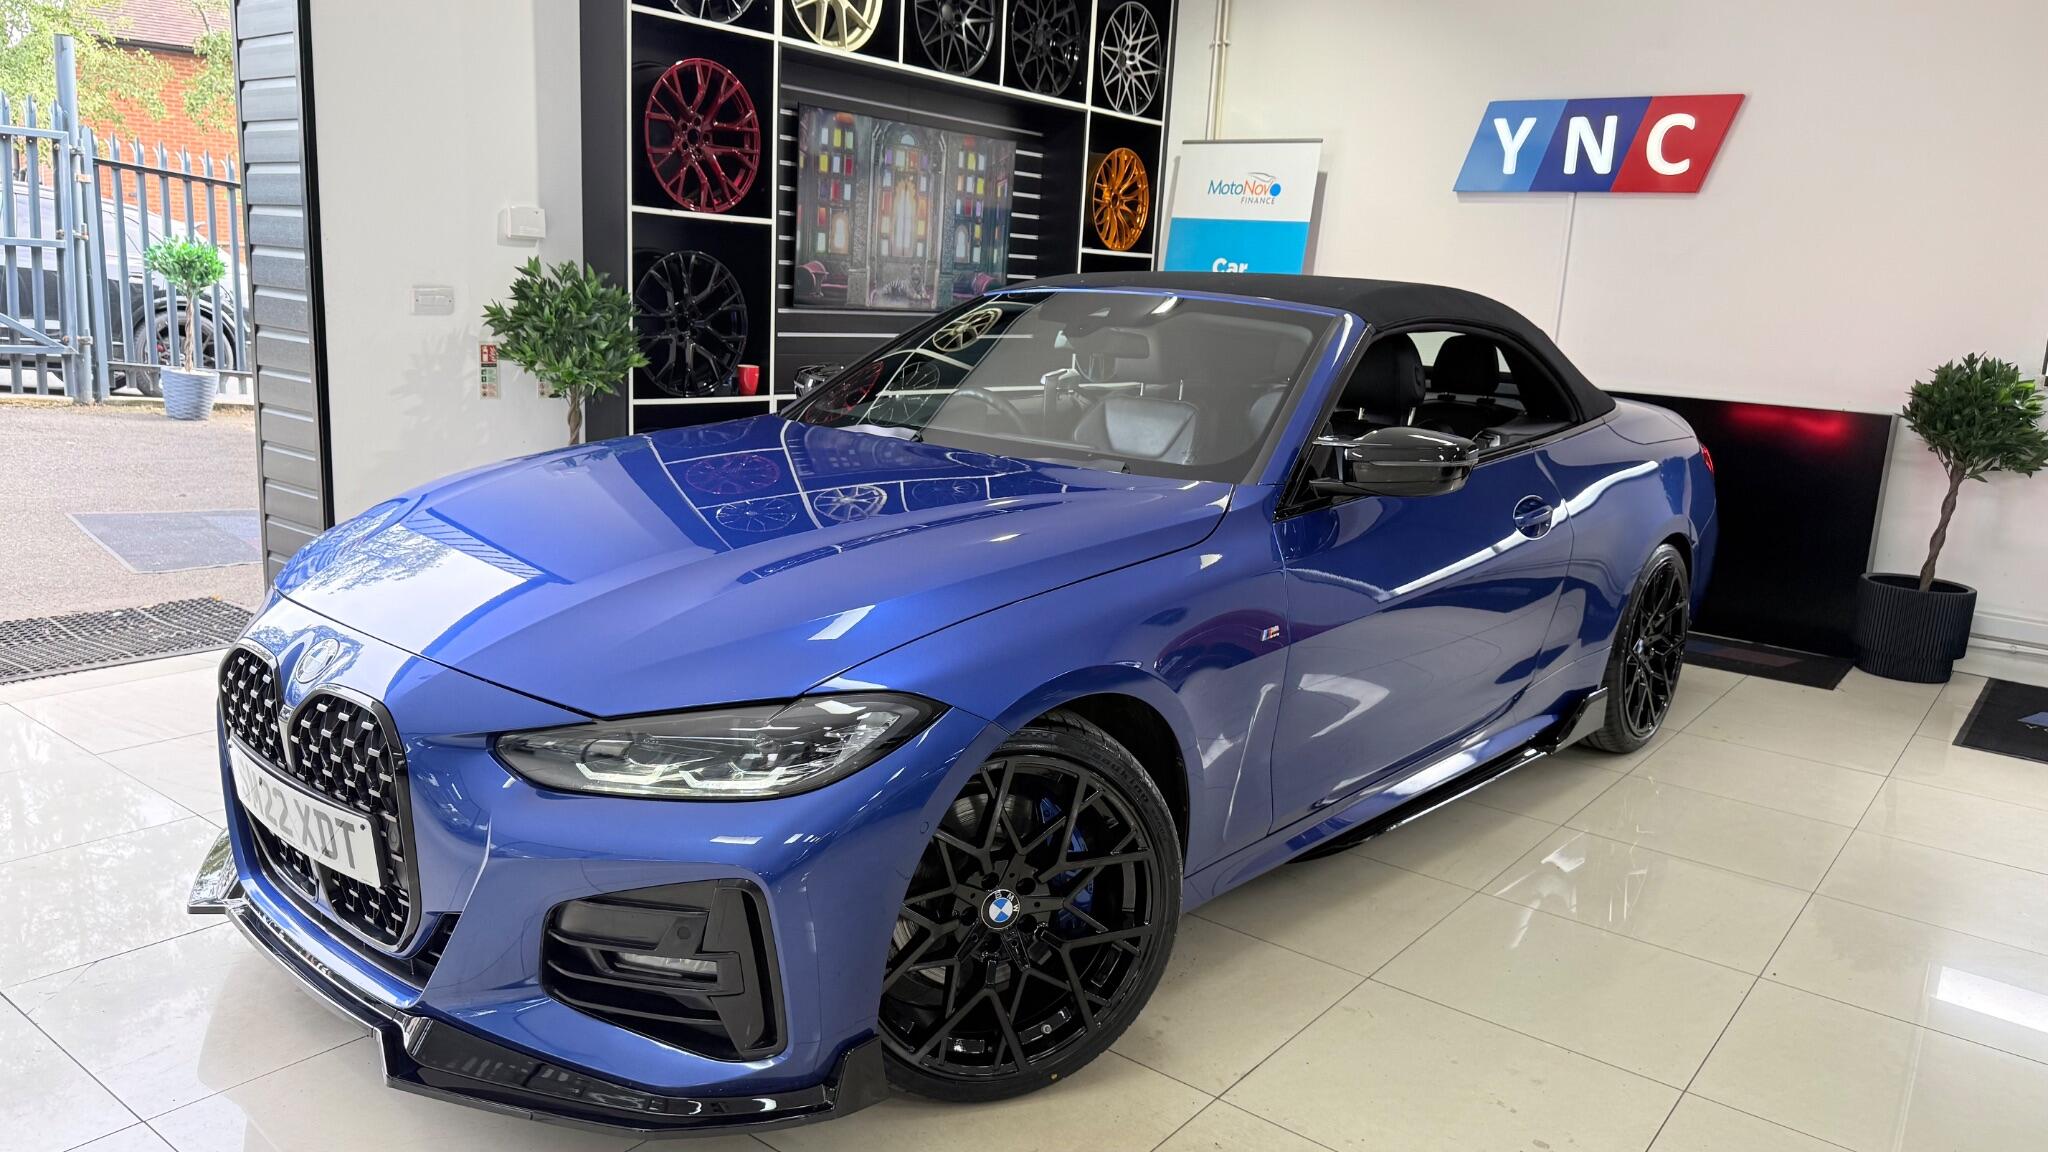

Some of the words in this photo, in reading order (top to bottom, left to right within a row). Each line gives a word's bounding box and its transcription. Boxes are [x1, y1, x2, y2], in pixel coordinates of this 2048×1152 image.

[1493, 113, 1696, 176] YNC
[1240, 196, 1276, 205] FINANCE
[1212, 257, 1248, 274] Car
[293, 798, 356, 870] XDT
